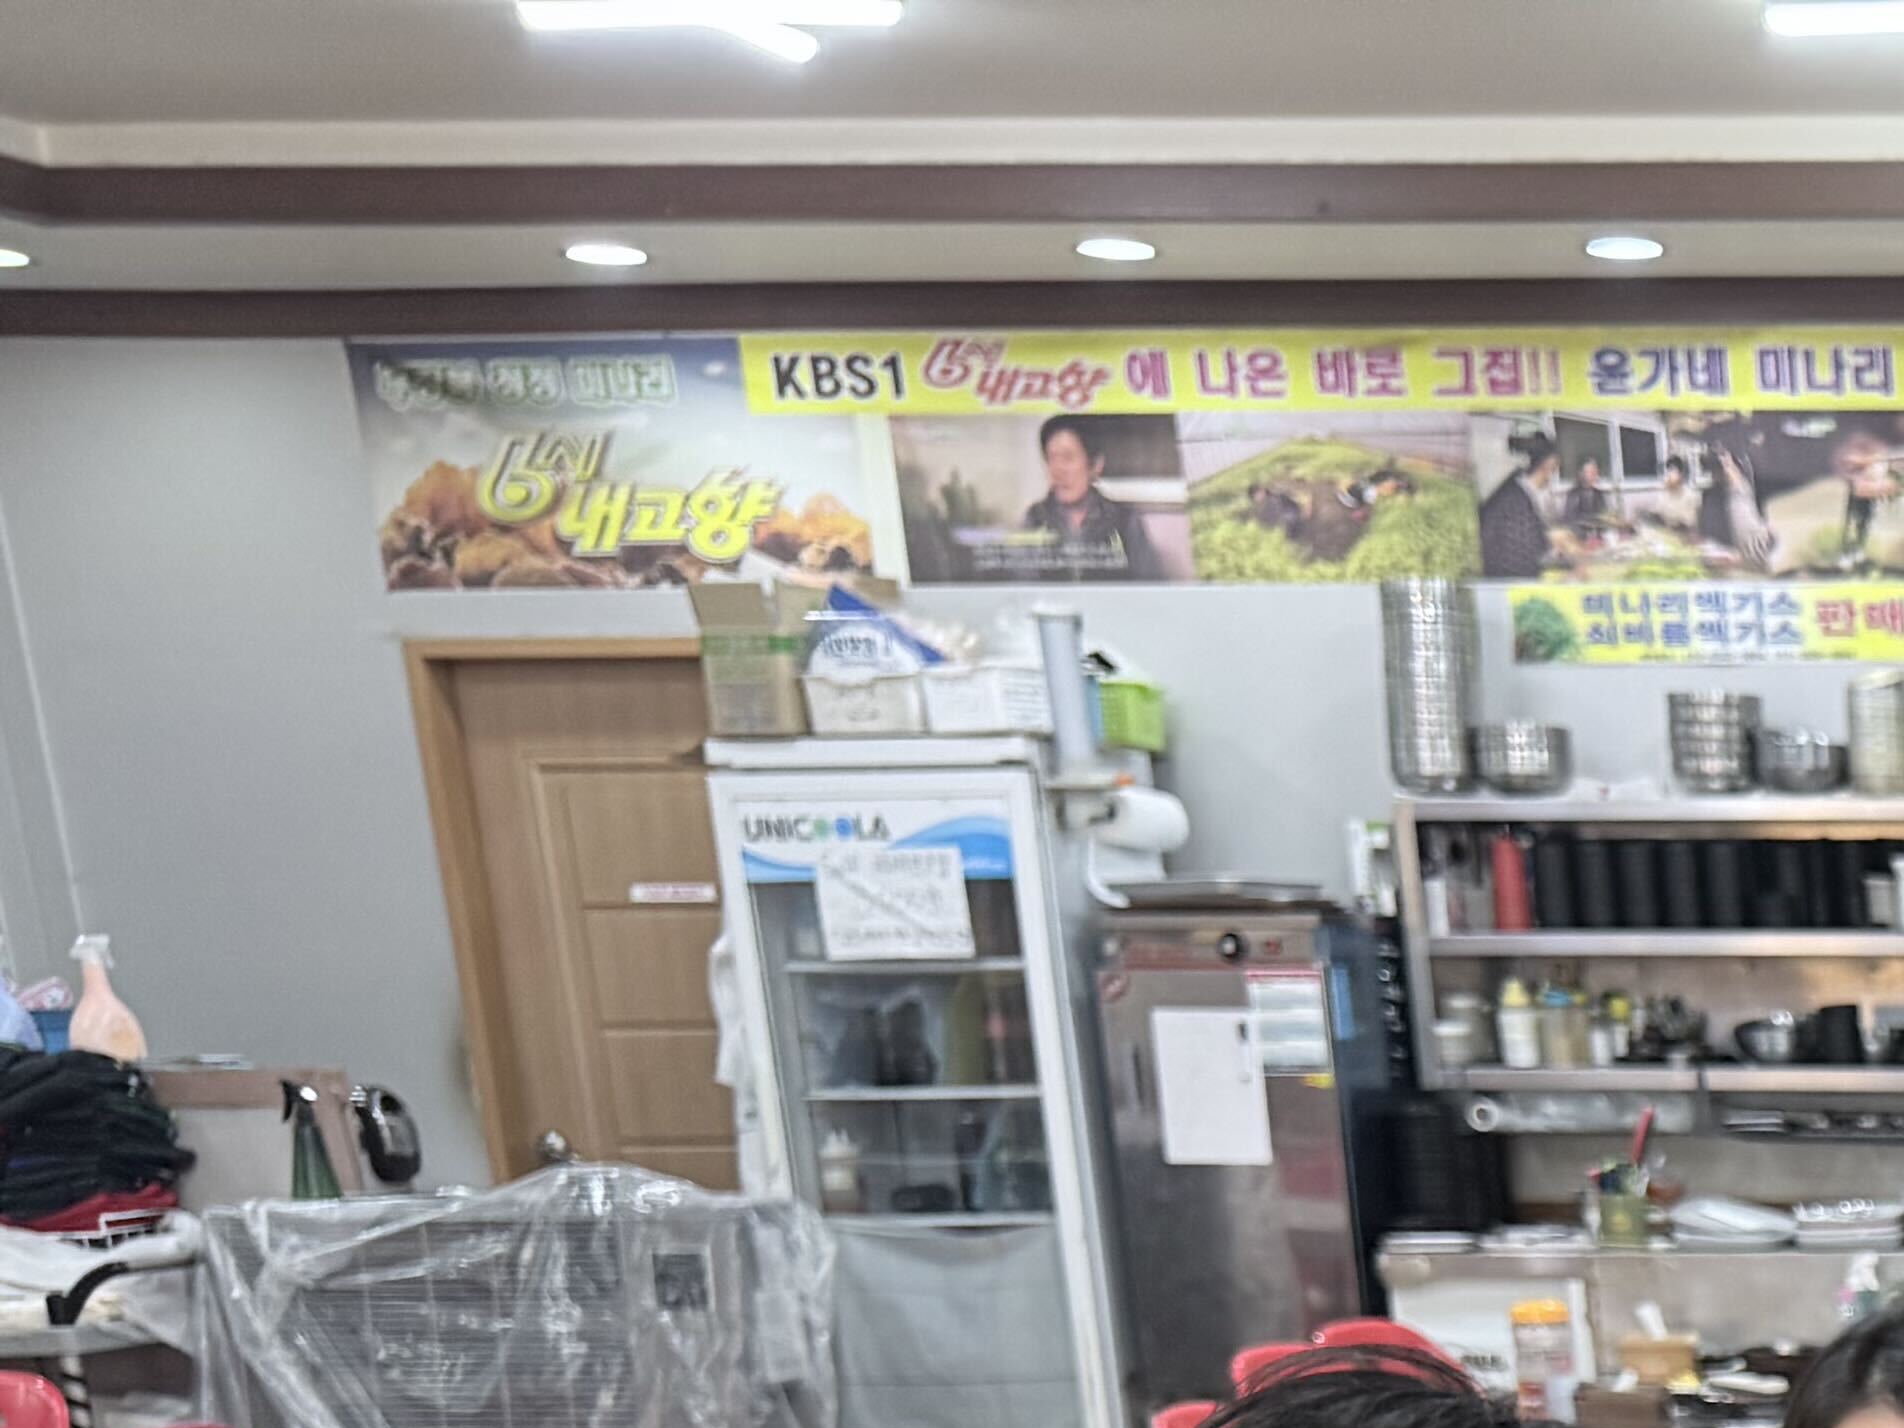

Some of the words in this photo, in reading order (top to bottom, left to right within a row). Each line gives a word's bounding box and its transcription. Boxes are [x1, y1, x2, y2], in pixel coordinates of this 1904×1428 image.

[772, 349, 906, 400] KBS1
[1125, 347, 1169, 399] 에
[1196, 346, 1289, 399] 나온
[1313, 346, 1407, 399] 바로
[1433, 345, 1562, 398] 그집!!
[1758, 345, 1894, 397] 미나리
[552, 467, 785, 562] 내고향
